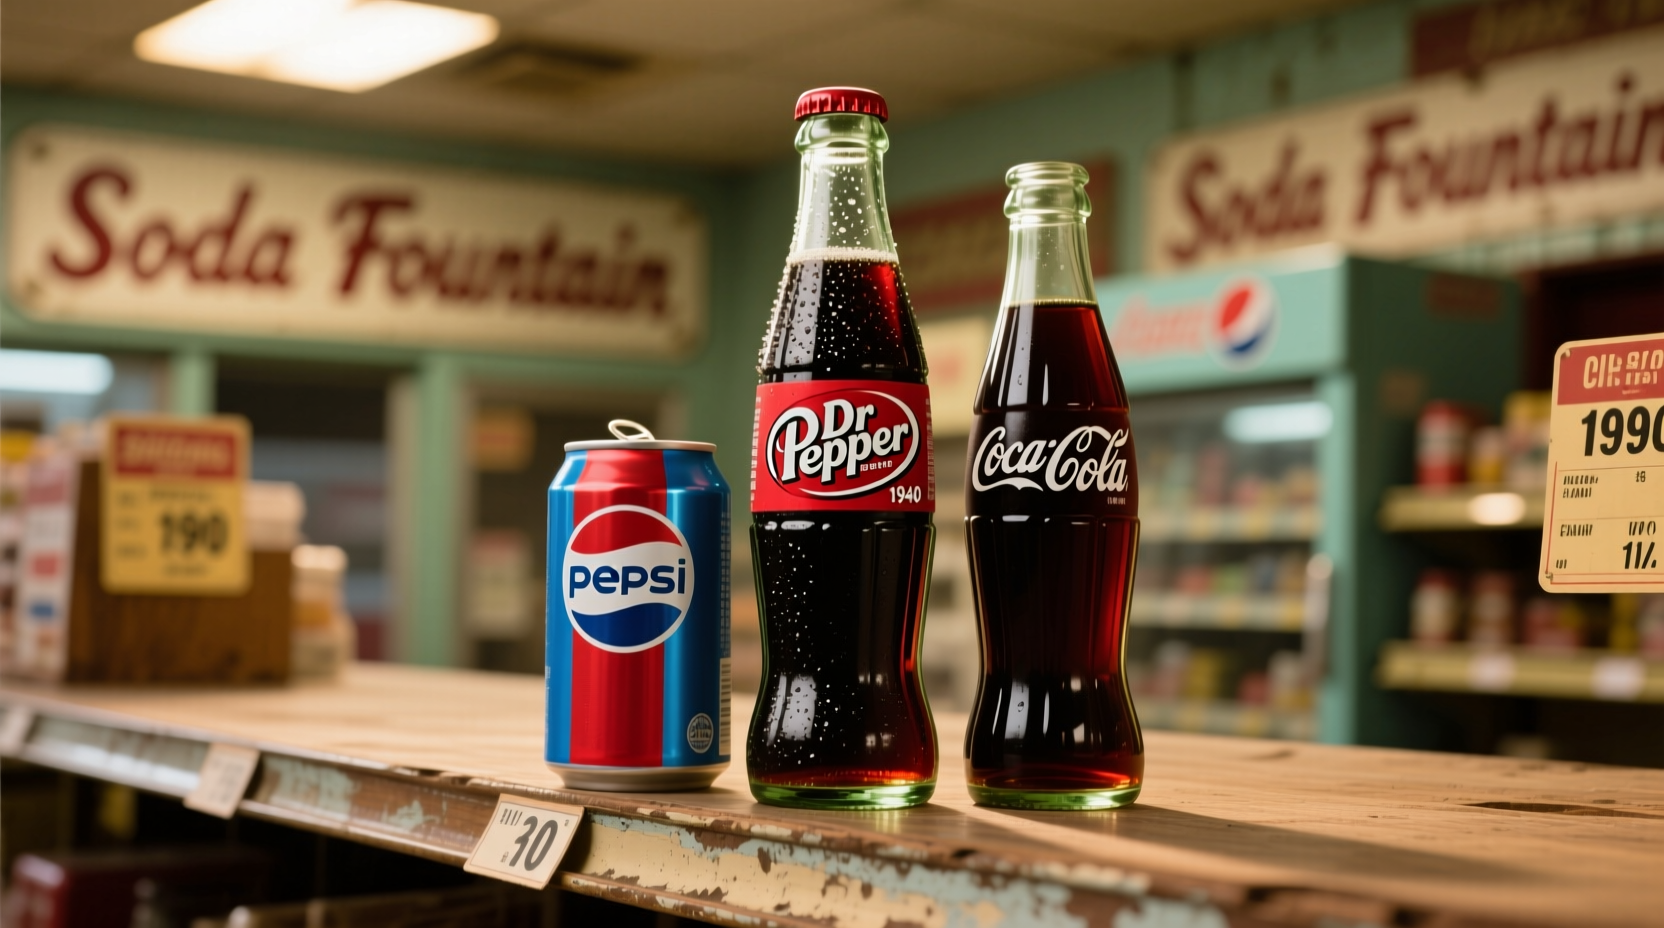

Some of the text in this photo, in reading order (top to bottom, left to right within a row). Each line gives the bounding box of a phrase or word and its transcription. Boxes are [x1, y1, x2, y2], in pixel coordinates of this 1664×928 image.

[1167, 140, 1328, 264] Soda
[49, 157, 675, 318] Soda Fountain
[766, 406, 909, 483] Pepper
[822, 399, 875, 440] Dr
[889, 486, 922, 504] 1940
[569, 558, 687, 598] pepsi
